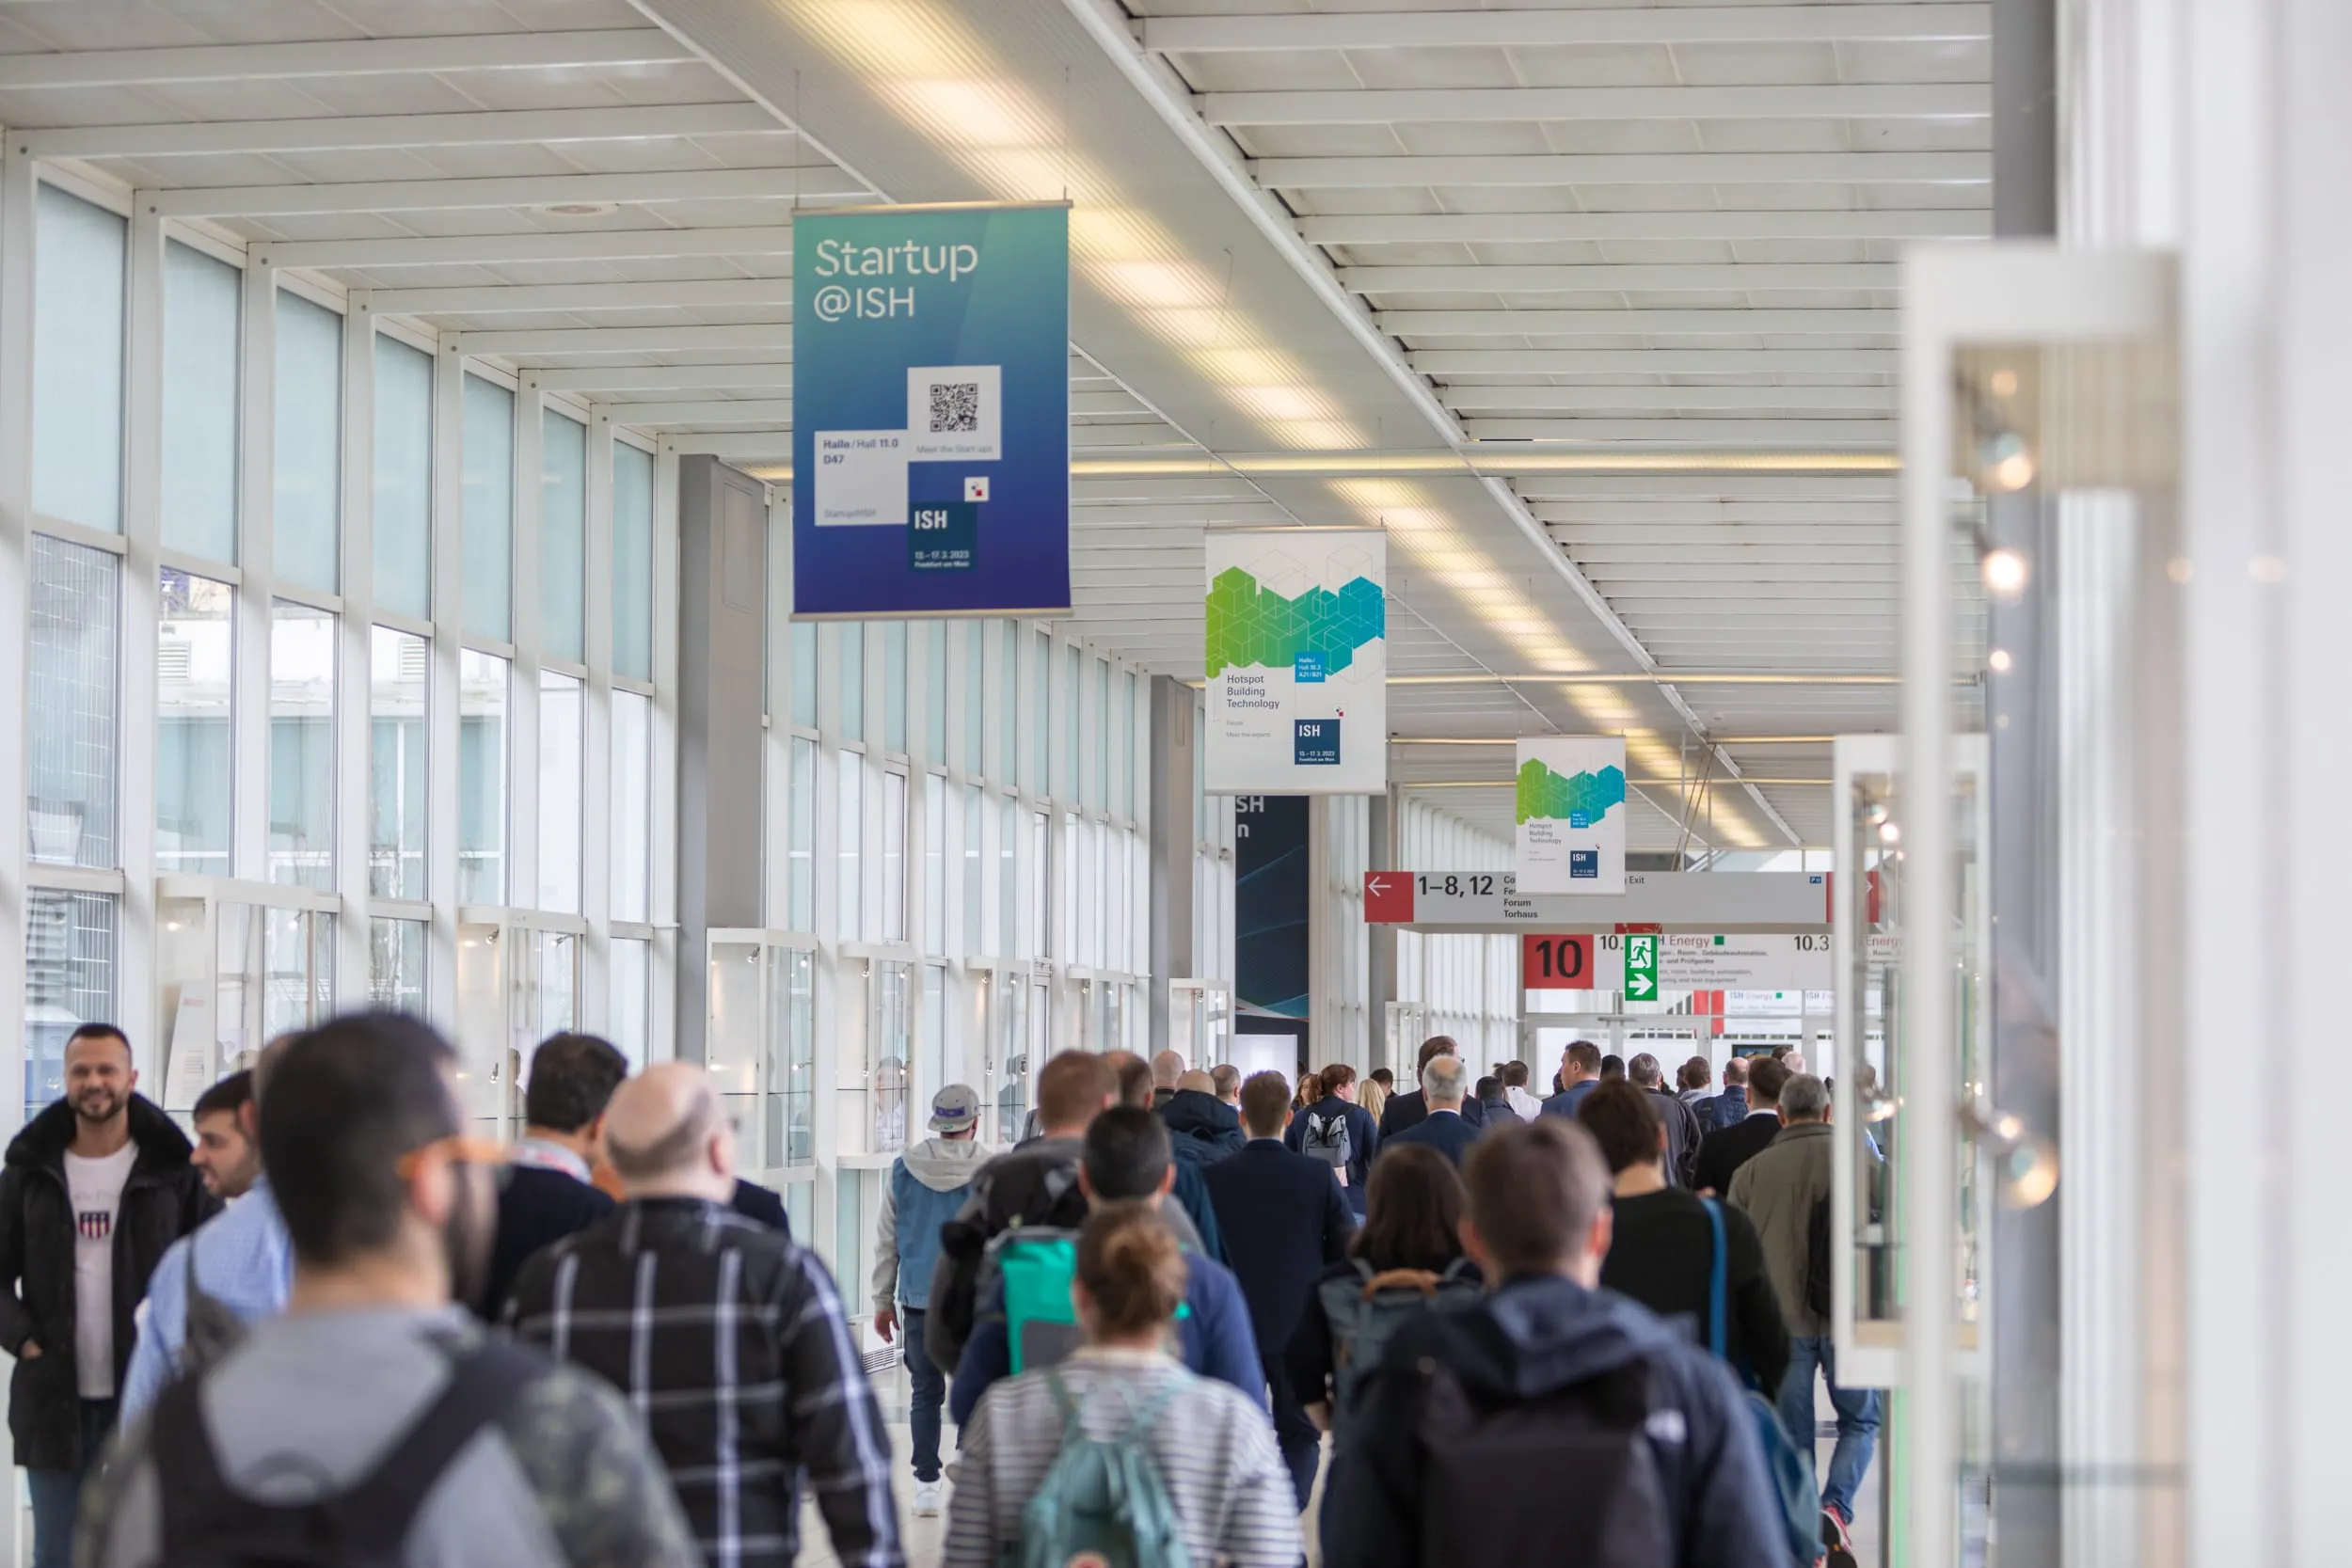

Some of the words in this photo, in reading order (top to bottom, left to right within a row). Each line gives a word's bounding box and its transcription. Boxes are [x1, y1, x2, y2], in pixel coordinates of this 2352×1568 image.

[814, 239, 978, 282] Startup
[814, 285, 914, 323] @ISH
[880, 438, 898, 449] 11.0
[823, 455, 844, 465] D47
[914, 510, 947, 530] ISH
[1227, 674, 1264, 686] Hotspot
[1227, 687, 1265, 698] Building
[1227, 699, 1280, 709] Technology
[1298, 724, 1320, 737] ISH
[1573, 853, 1586, 862] ISH
[1470, 876, 1493, 895] 12
[1629, 875, 1645, 884] Exit
[1503, 898, 1532, 907] Forum
[1503, 910, 1538, 918] Torhaus
[1669, 935, 1709, 948] Energy
[1793, 934, 1829, 951] 10.3
[1535, 940, 1582, 978] 10
